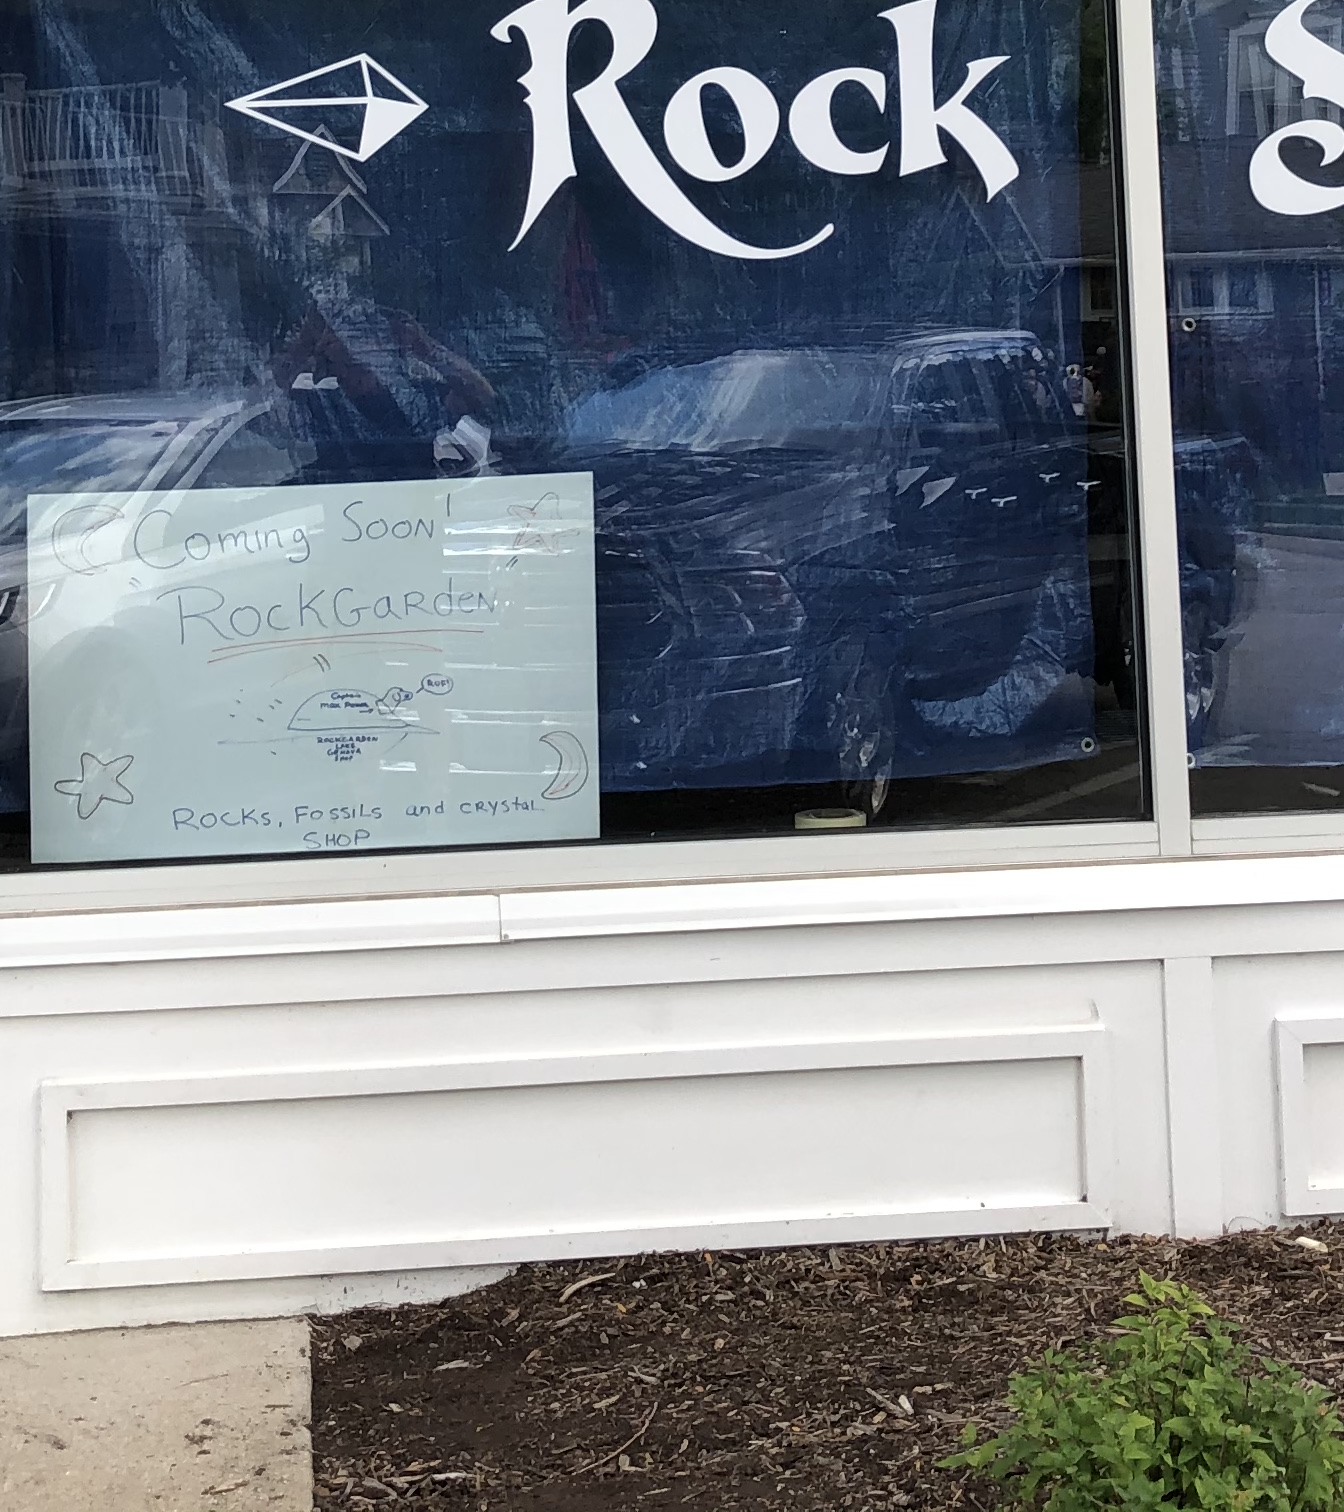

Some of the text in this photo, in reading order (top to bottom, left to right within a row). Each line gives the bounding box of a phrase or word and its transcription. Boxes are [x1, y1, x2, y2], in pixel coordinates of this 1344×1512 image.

[133, 509, 311, 569] Coming
[404, 799, 446, 816] and
[302, 829, 371, 850] SHOP
